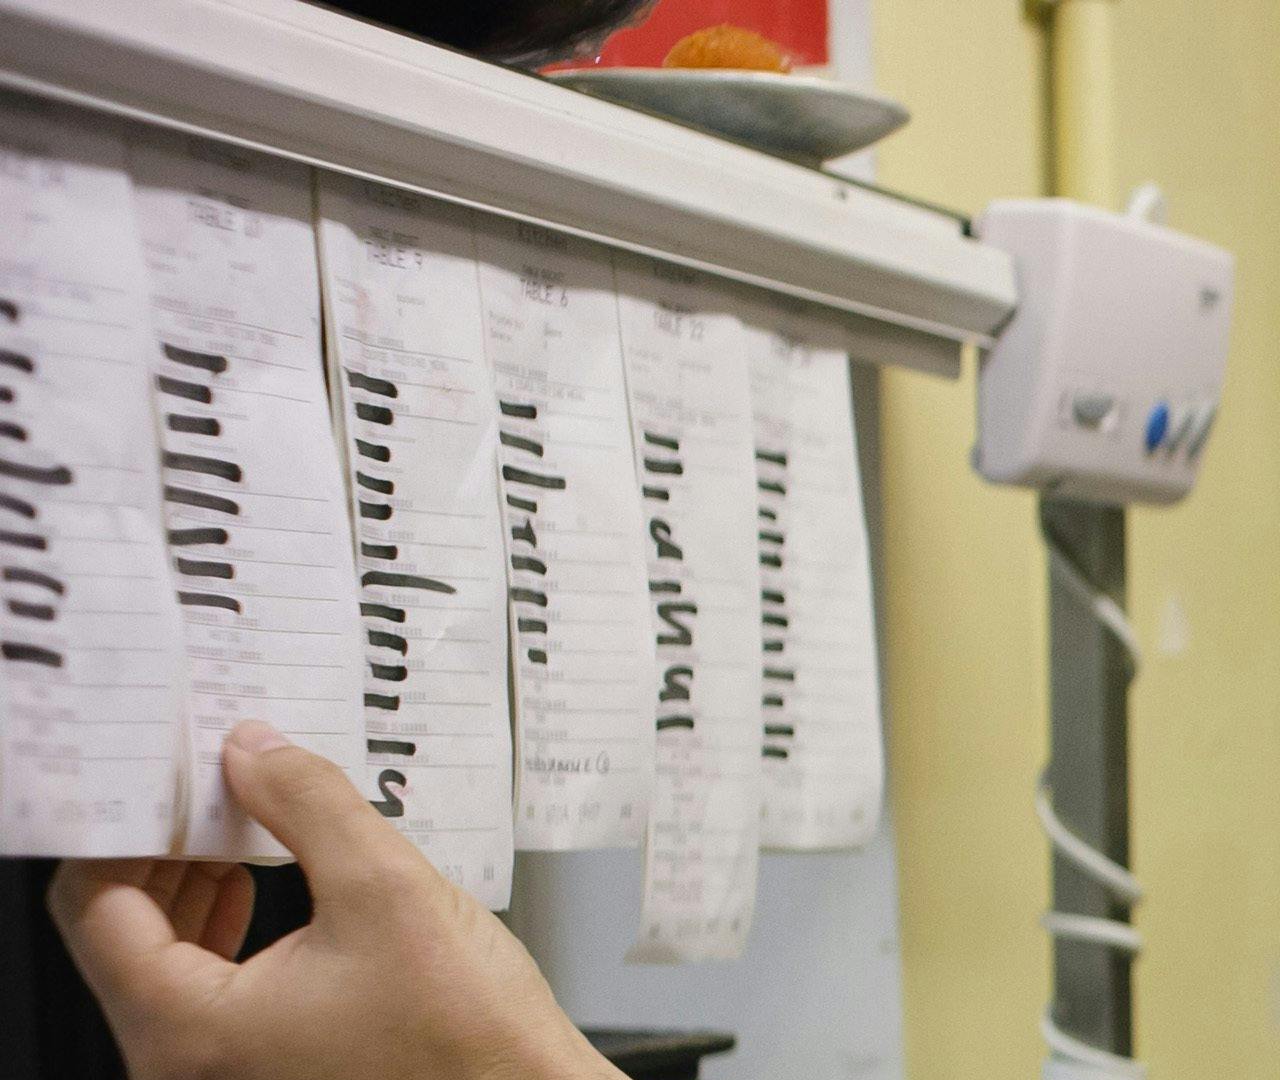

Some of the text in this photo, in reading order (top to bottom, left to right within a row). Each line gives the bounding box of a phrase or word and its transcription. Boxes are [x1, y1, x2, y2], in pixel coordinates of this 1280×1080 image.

[364, 239, 407, 270] TABLE
[520, 277, 569, 308] TABLE 6
